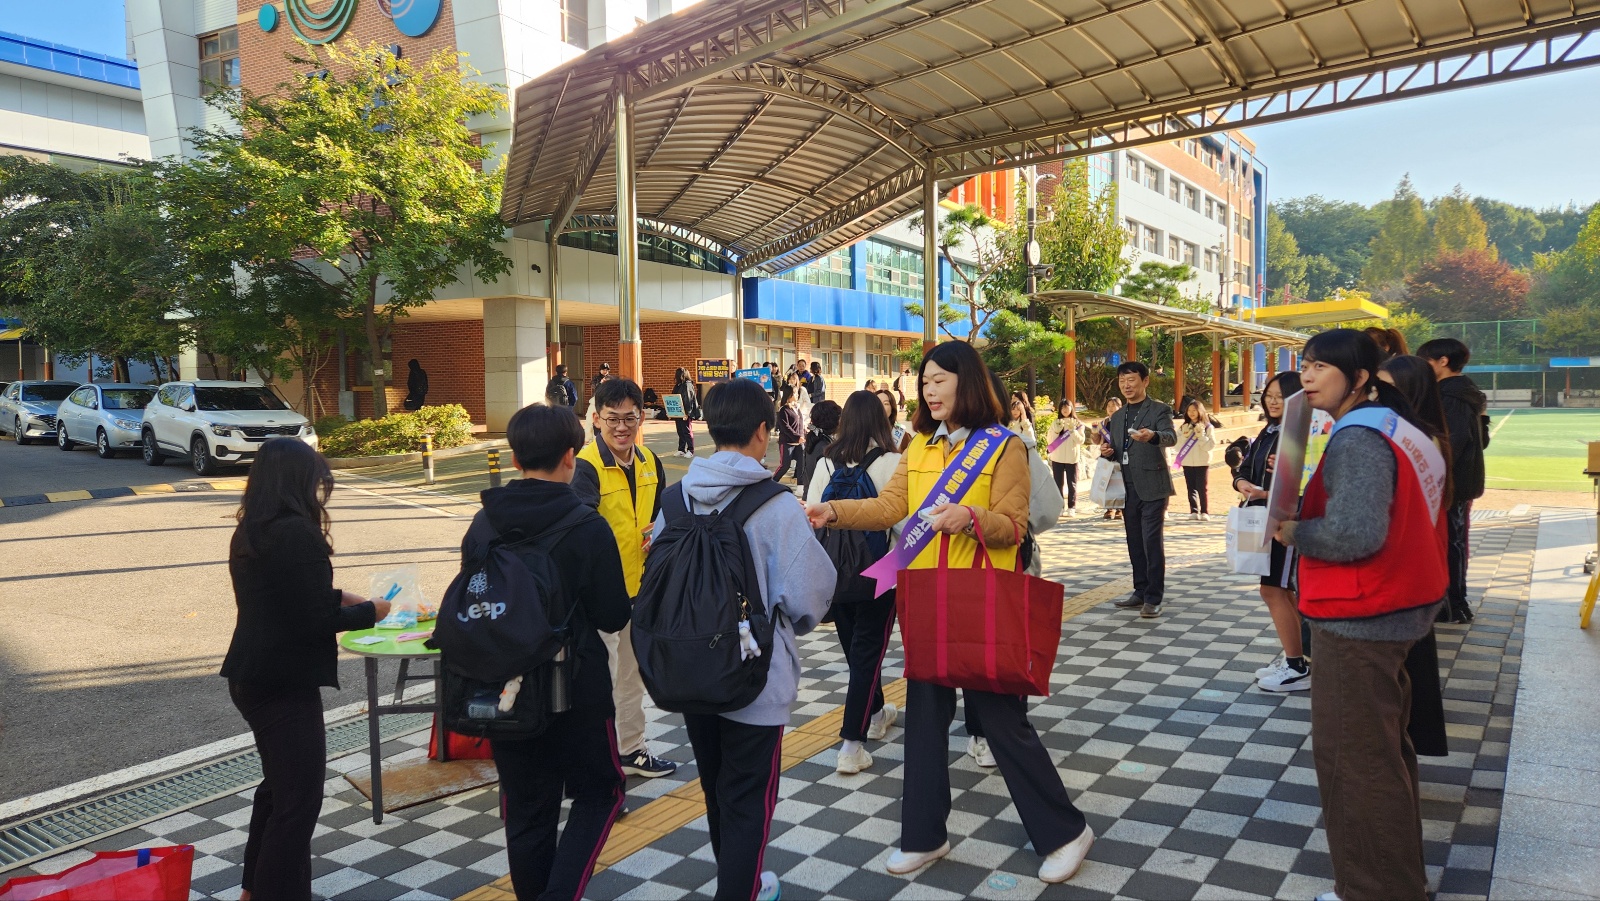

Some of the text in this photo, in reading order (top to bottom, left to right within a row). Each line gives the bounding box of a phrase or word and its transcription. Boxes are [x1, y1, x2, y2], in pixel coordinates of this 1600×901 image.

[714, 370, 724, 378] 당신
[962, 438, 990, 470] 소중한
[945, 469, 968, 495] 생명
[457, 601, 506, 622] Jeep
[634, 755, 648, 767] N
